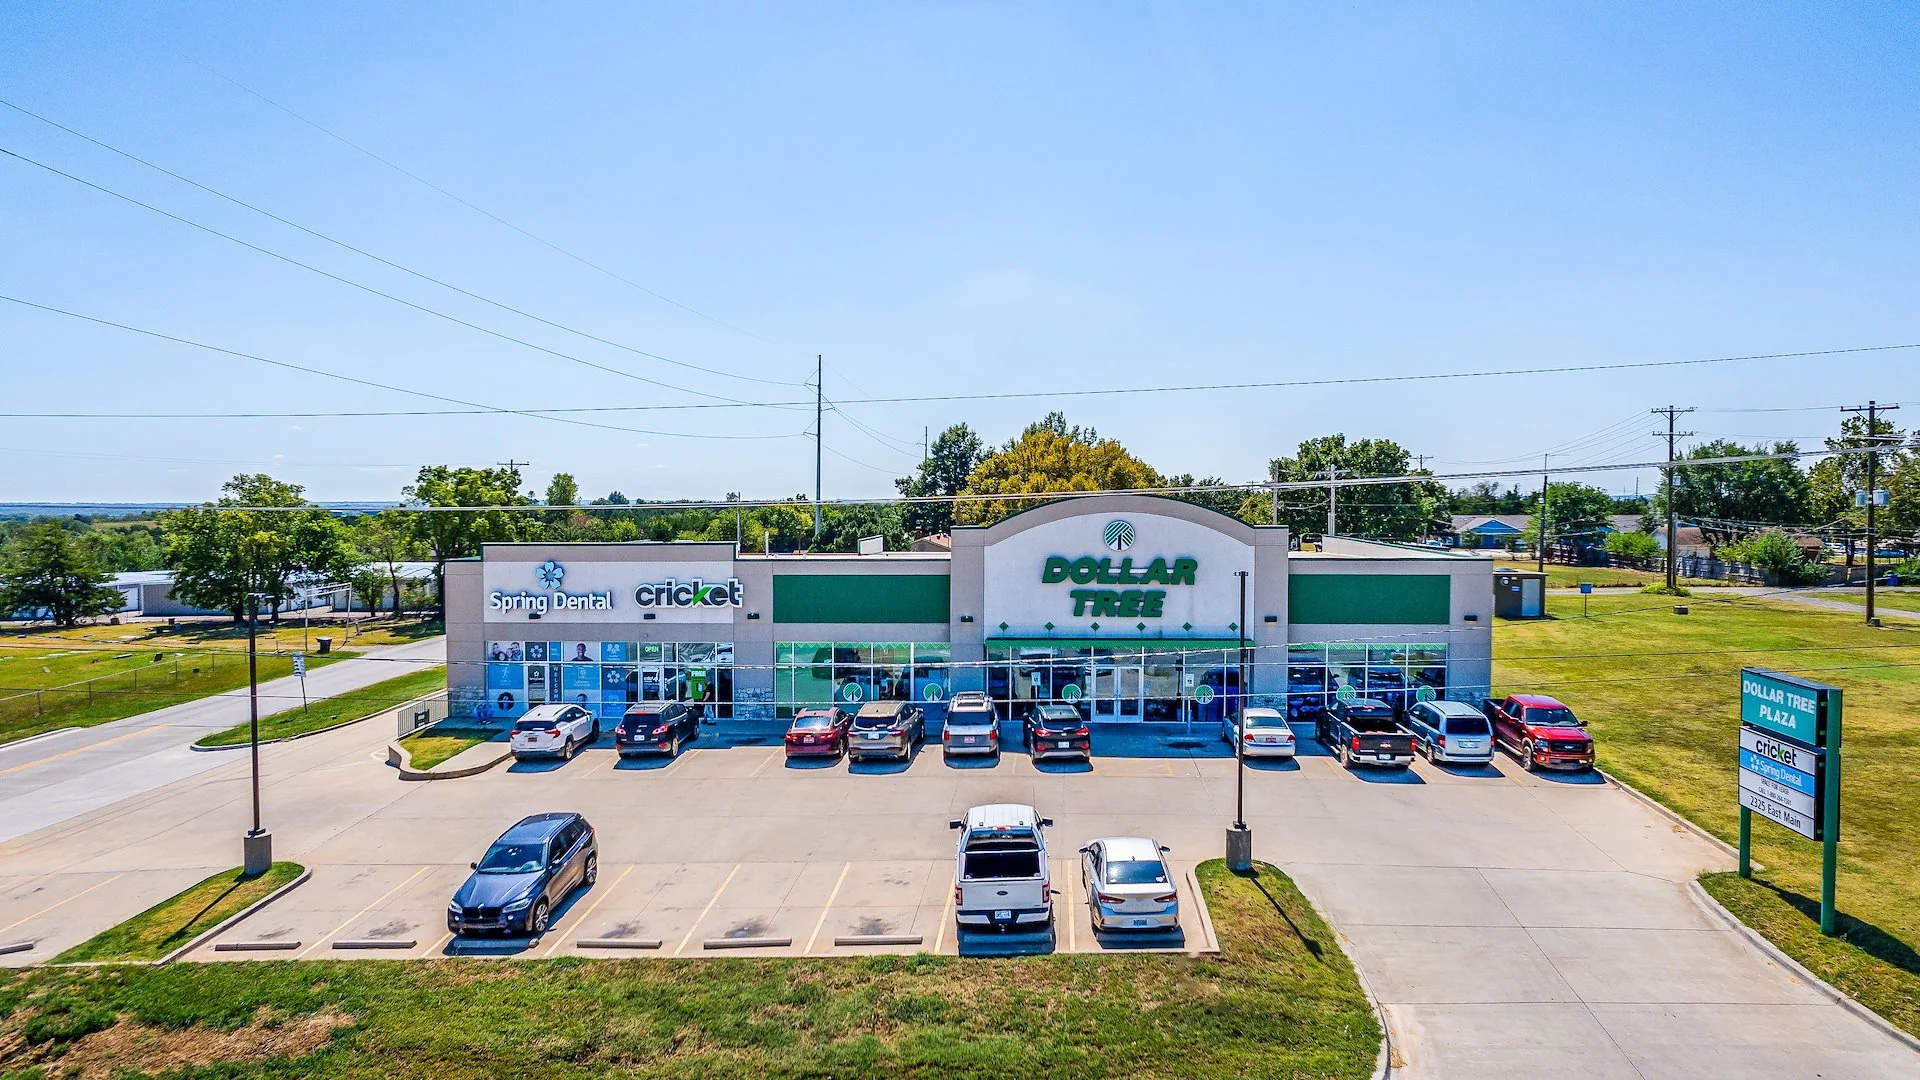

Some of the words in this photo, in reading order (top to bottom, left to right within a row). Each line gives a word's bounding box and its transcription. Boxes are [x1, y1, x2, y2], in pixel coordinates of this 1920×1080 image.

[1042, 557, 1198, 585] DOLLAR
[490, 591, 548, 614] Spring
[553, 591, 613, 610] Dental
[635, 578, 744, 609] cricket
[1070, 590, 1167, 617] TREE
[1743, 680, 1784, 704] DOLLAR
[1787, 692, 1816, 714] TREE
[1760, 704, 1796, 729] PLAZA
[1756, 739, 1797, 766] cricket
[1760, 760, 1780, 779] Spring
[1780, 769, 1802, 786] Dental
[1760, 778, 1770, 787] SPACE
[1779, 785, 1789, 795] LEASE
[1758, 786, 1766, 795] CALL
[1750, 795, 1766, 811] 2325
[1767, 804, 1781, 819] East
[1783, 811, 1801, 828] Main
